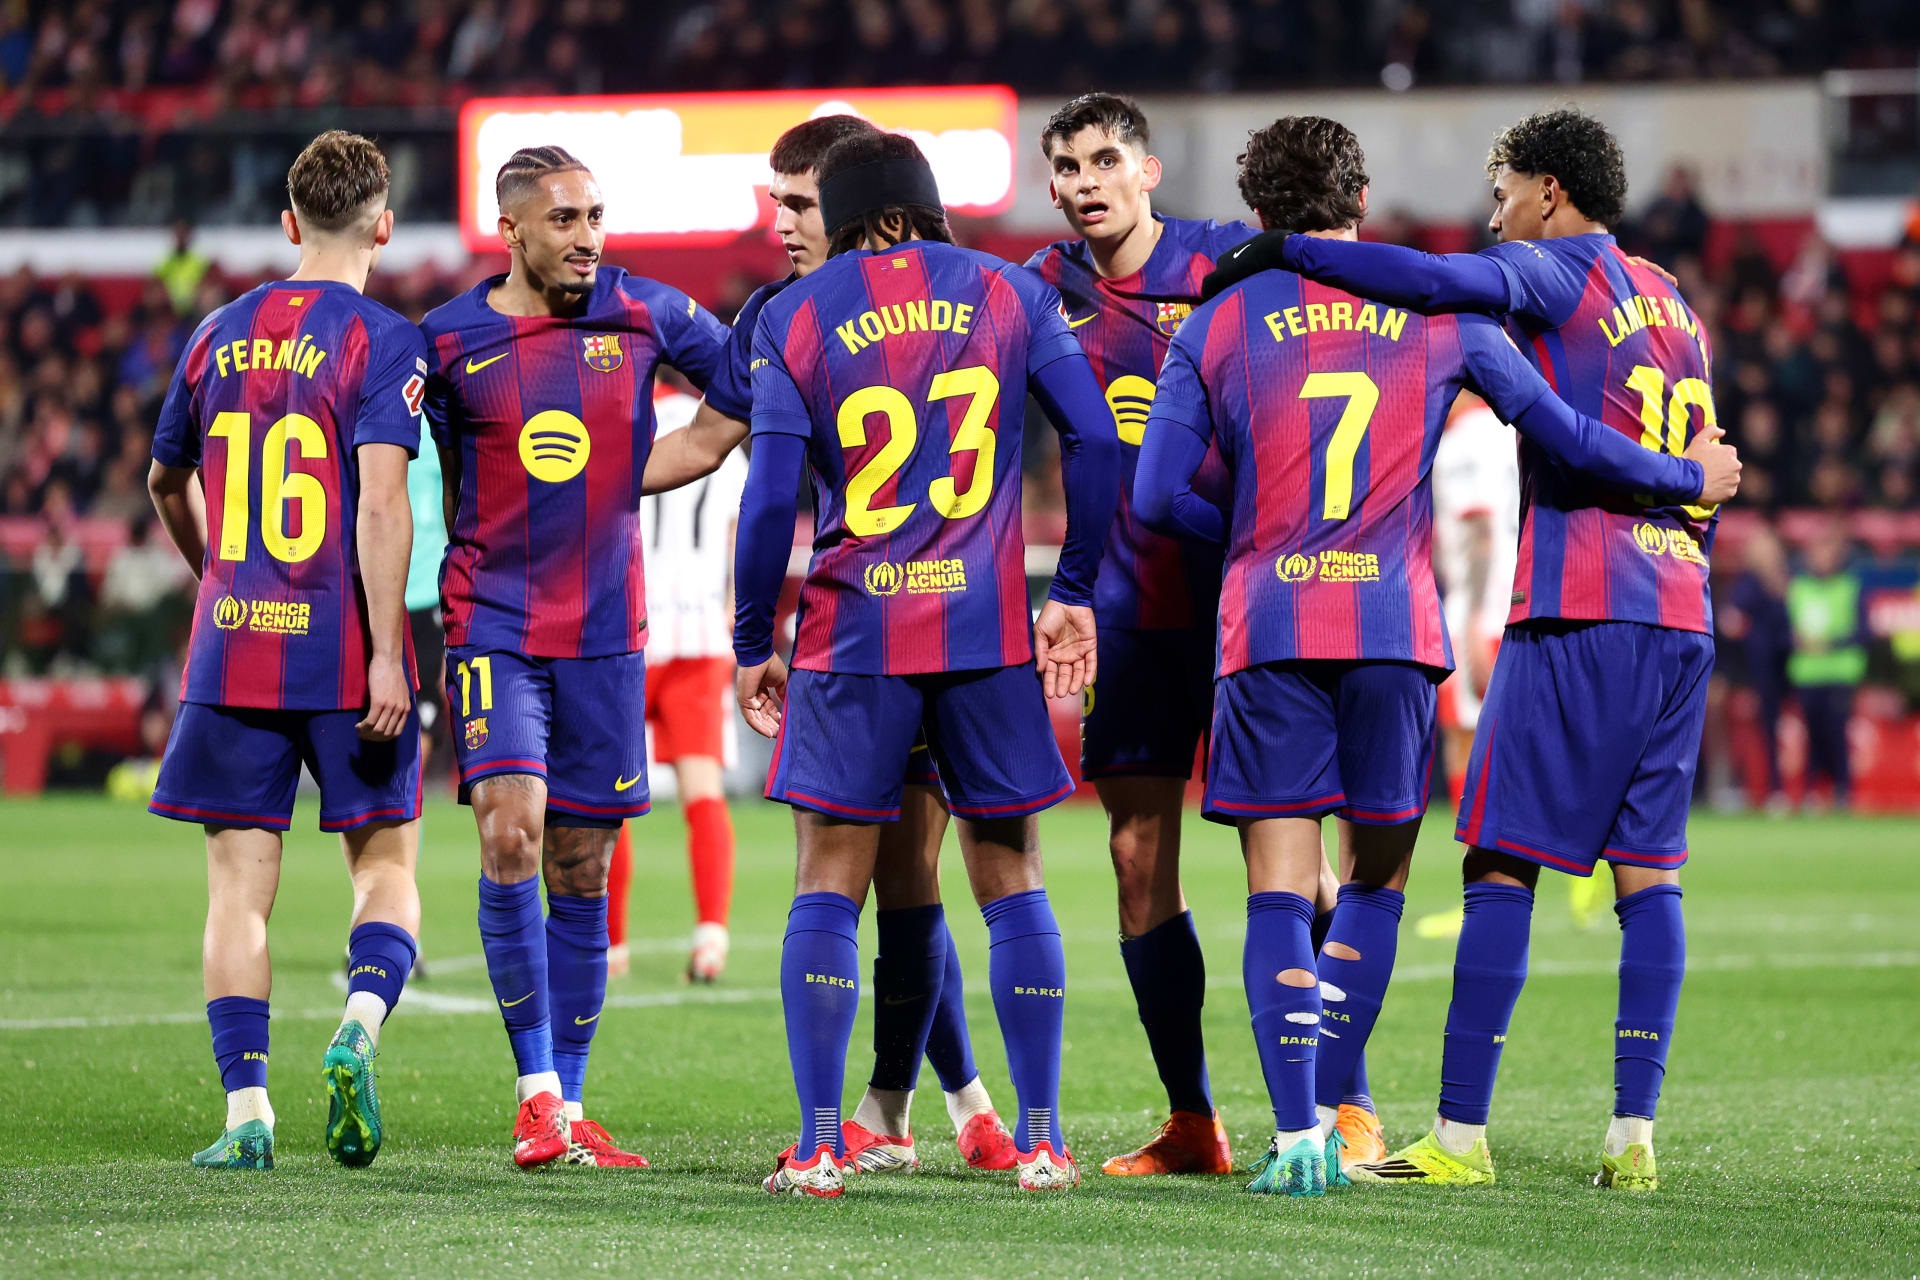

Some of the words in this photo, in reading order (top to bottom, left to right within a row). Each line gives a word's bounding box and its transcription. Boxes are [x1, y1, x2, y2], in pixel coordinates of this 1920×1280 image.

[836, 299, 974, 355] KOUNDE
[1264, 301, 1408, 342] FERRAN
[836, 365, 1000, 537] 23
[1298, 371, 1380, 520] 7
[1624, 364, 1717, 520] 10
[207, 411, 328, 563] 16
[906, 559, 965, 575] UNHCR
[1319, 563, 1380, 577] ACNUR
[1320, 550, 1378, 565] UNHCR
[906, 572, 967, 589] ACNUR
[249, 613, 310, 629] ACNUR
[251, 600, 311, 616] UNHCR
[457, 656, 493, 717] 11
